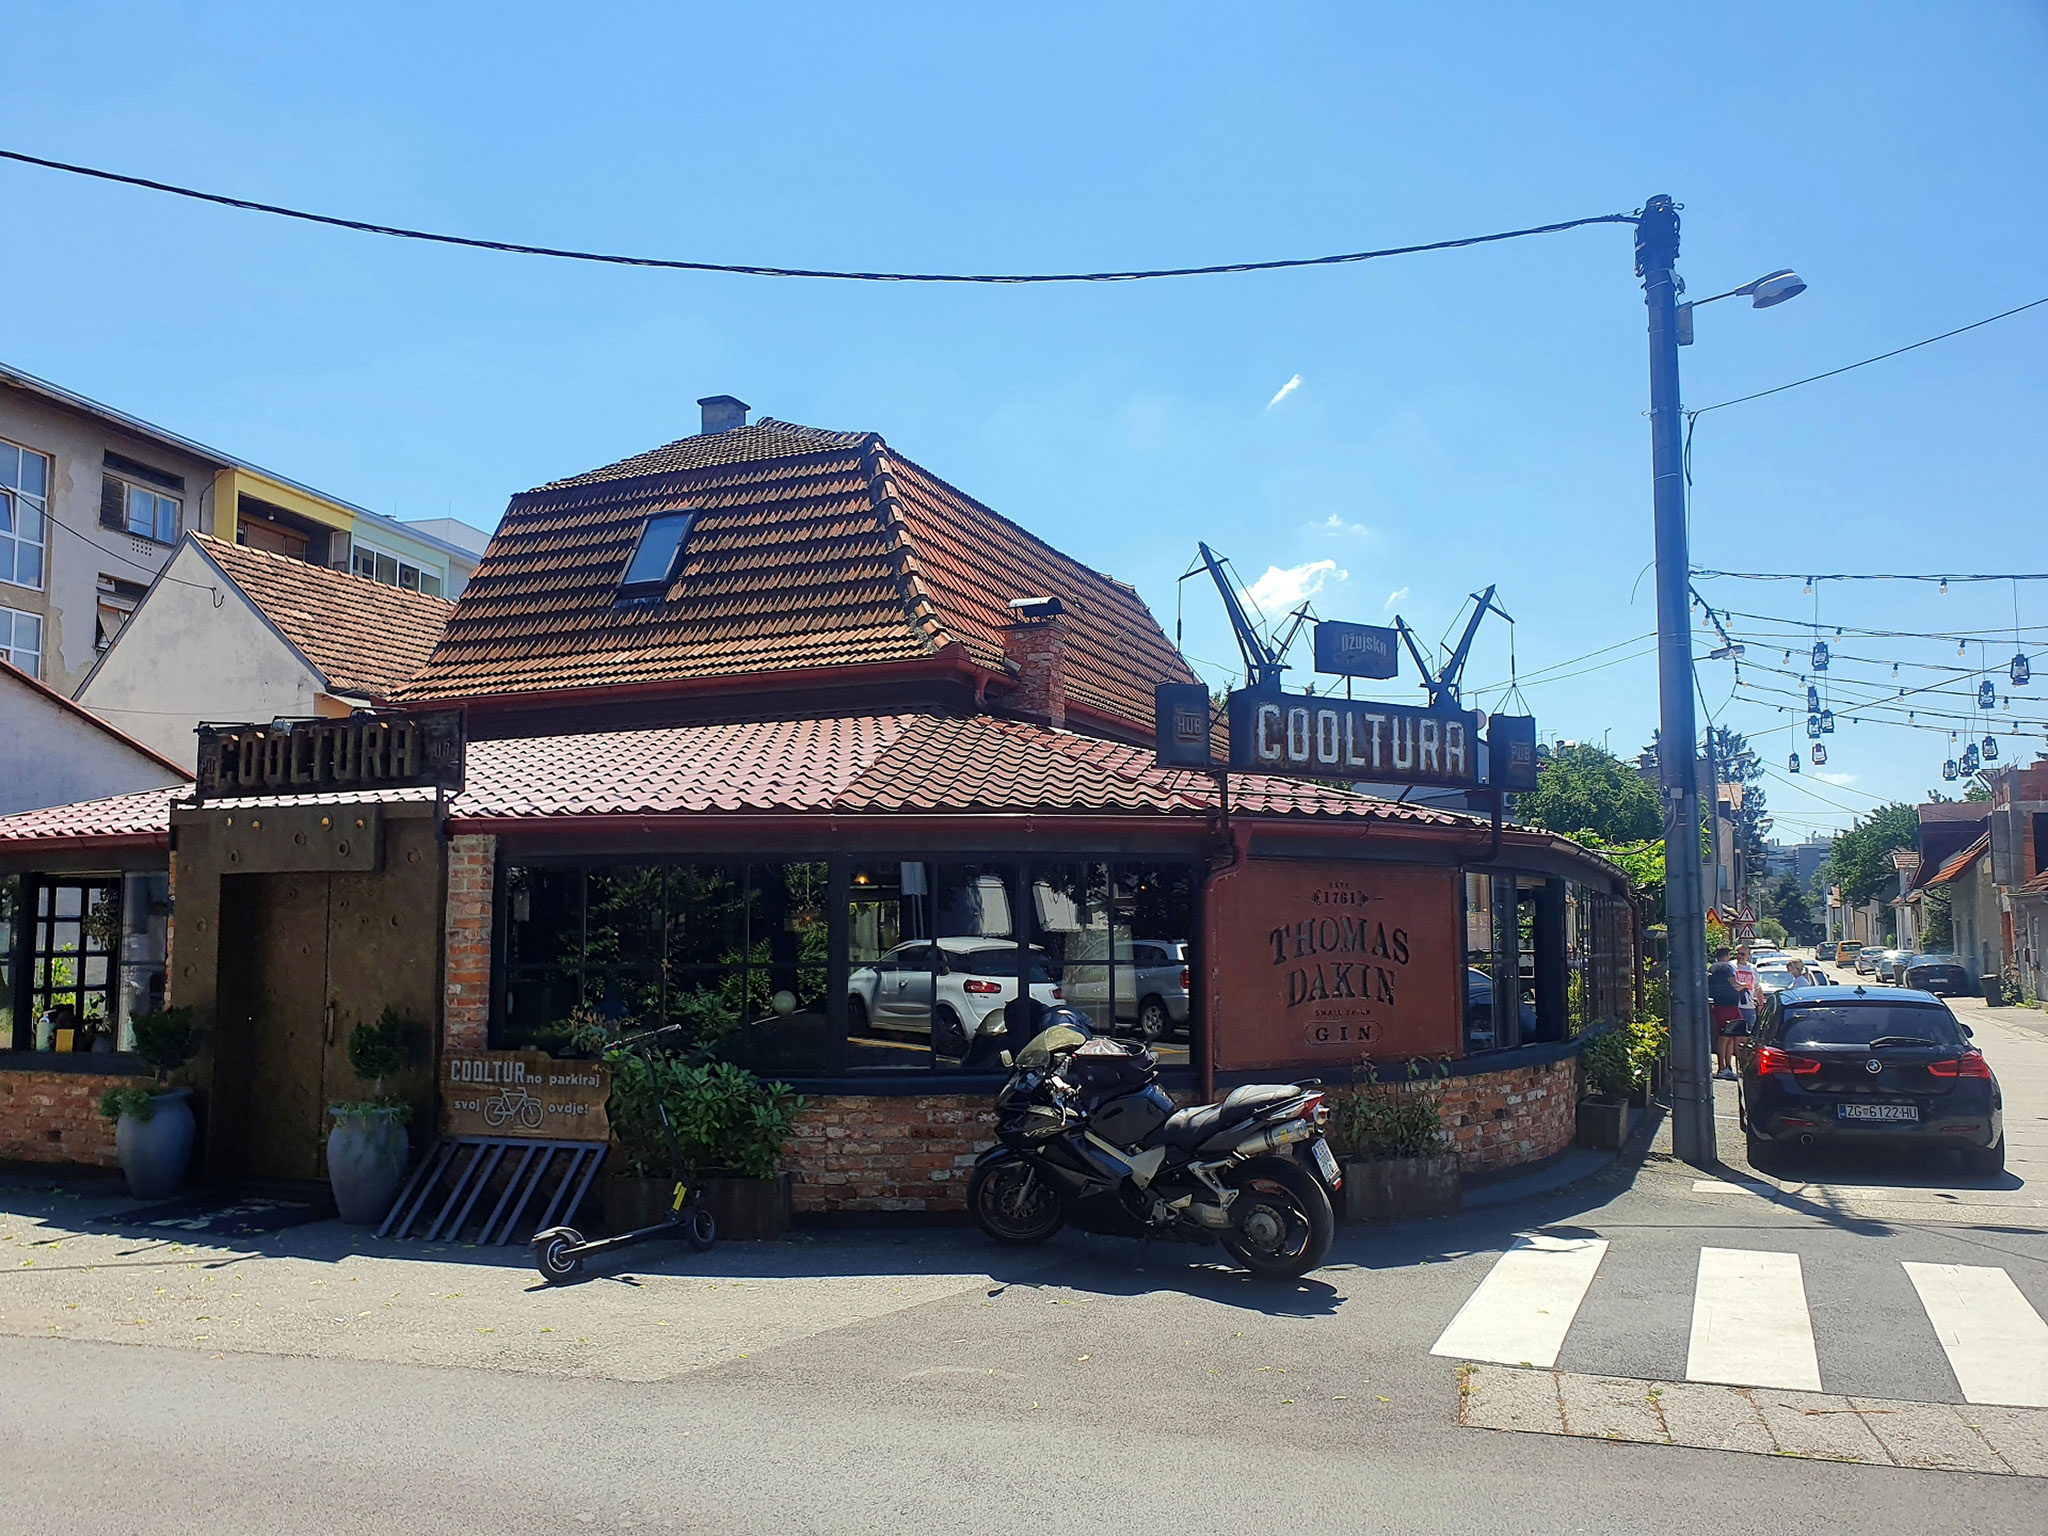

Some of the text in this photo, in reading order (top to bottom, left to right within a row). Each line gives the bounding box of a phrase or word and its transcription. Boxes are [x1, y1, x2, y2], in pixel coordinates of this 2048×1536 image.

[1178, 717, 1202, 734] HUB
[1257, 703, 1466, 774] COOLTURA
[214, 720, 418, 787] COOLTURA
[1324, 892, 1355, 904] 1761
[1269, 915, 1410, 965] THOMAS
[1287, 962, 1397, 1008] DAKIN
[1315, 1026, 1372, 1042] GIN
[549, 1073, 601, 1087] parkiraj
[454, 1099, 589, 1115] svoj ovdje!
[1846, 1105, 1862, 1117] ZG
